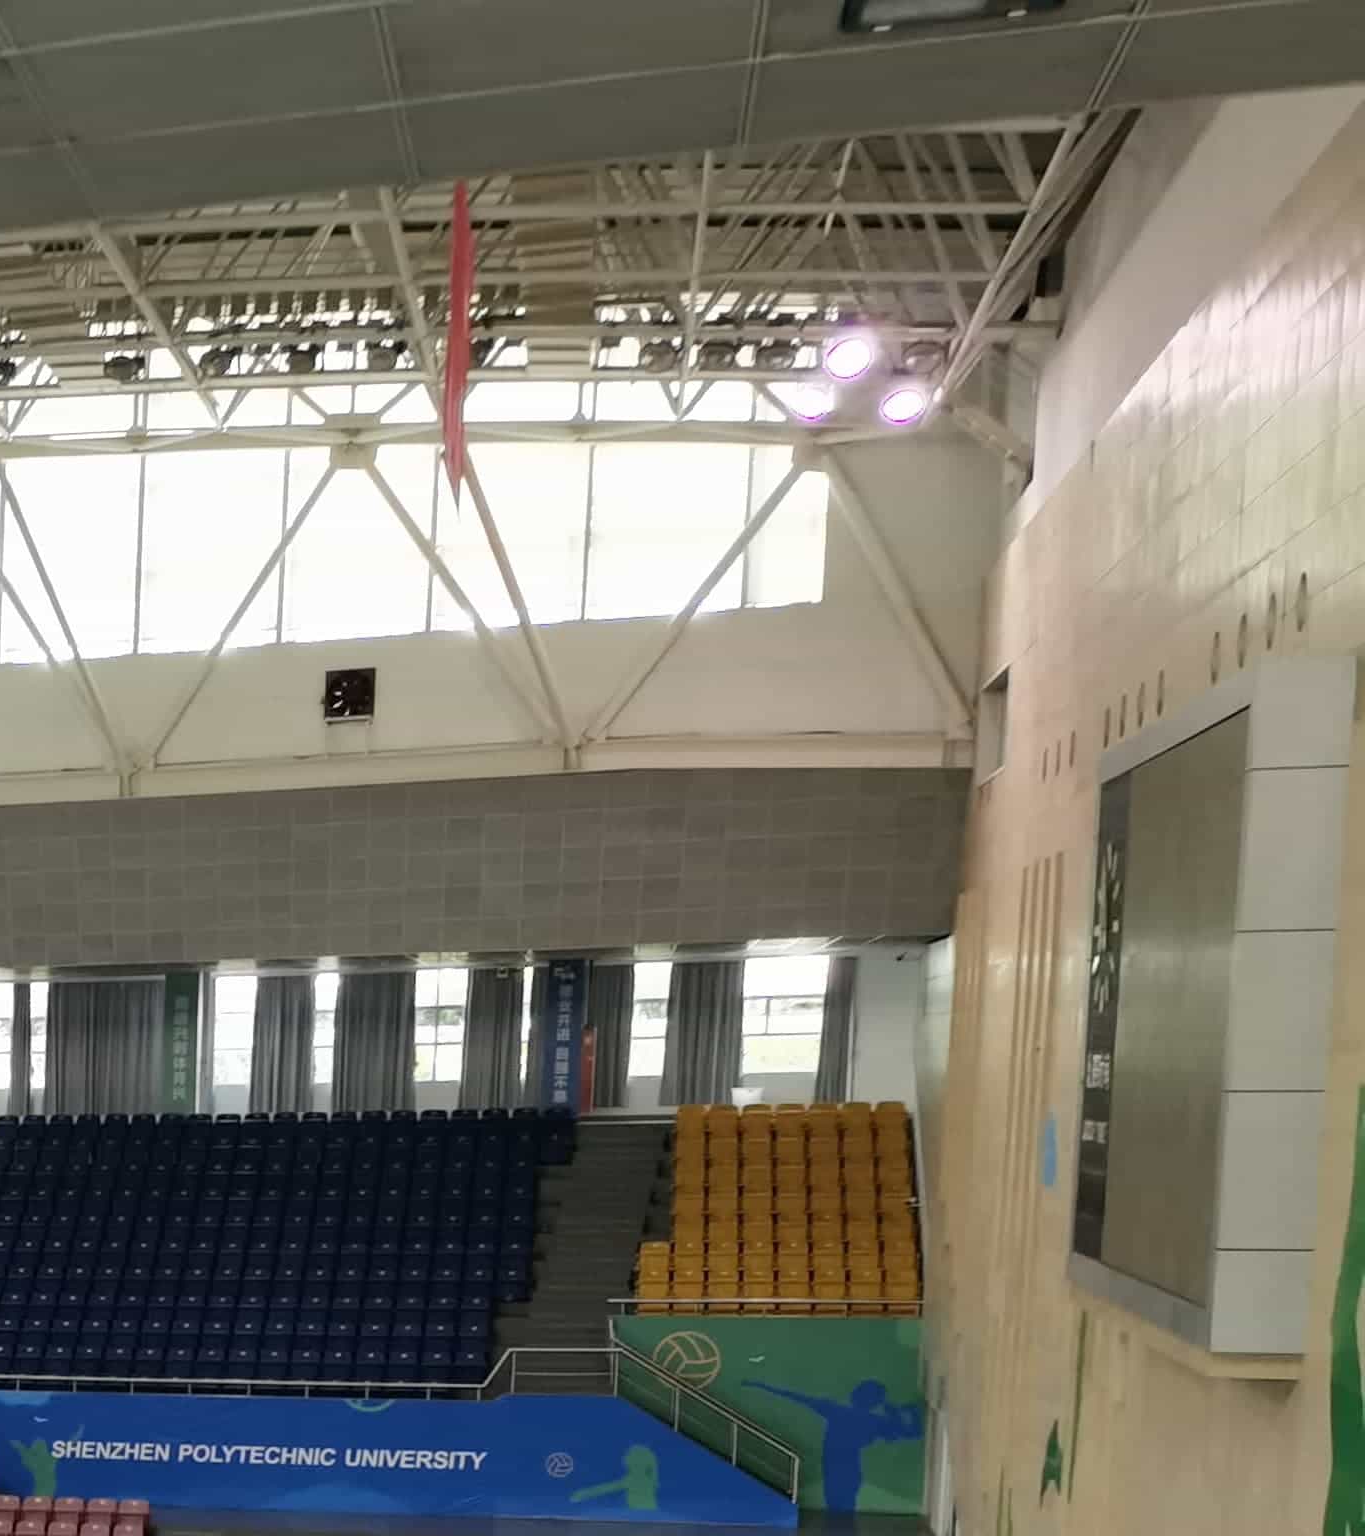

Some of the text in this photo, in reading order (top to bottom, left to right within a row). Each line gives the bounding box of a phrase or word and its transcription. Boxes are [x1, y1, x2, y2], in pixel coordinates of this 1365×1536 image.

[51, 1440, 486, 1470] SHENZHEN POLYTECHNIC UNIVERSITY
